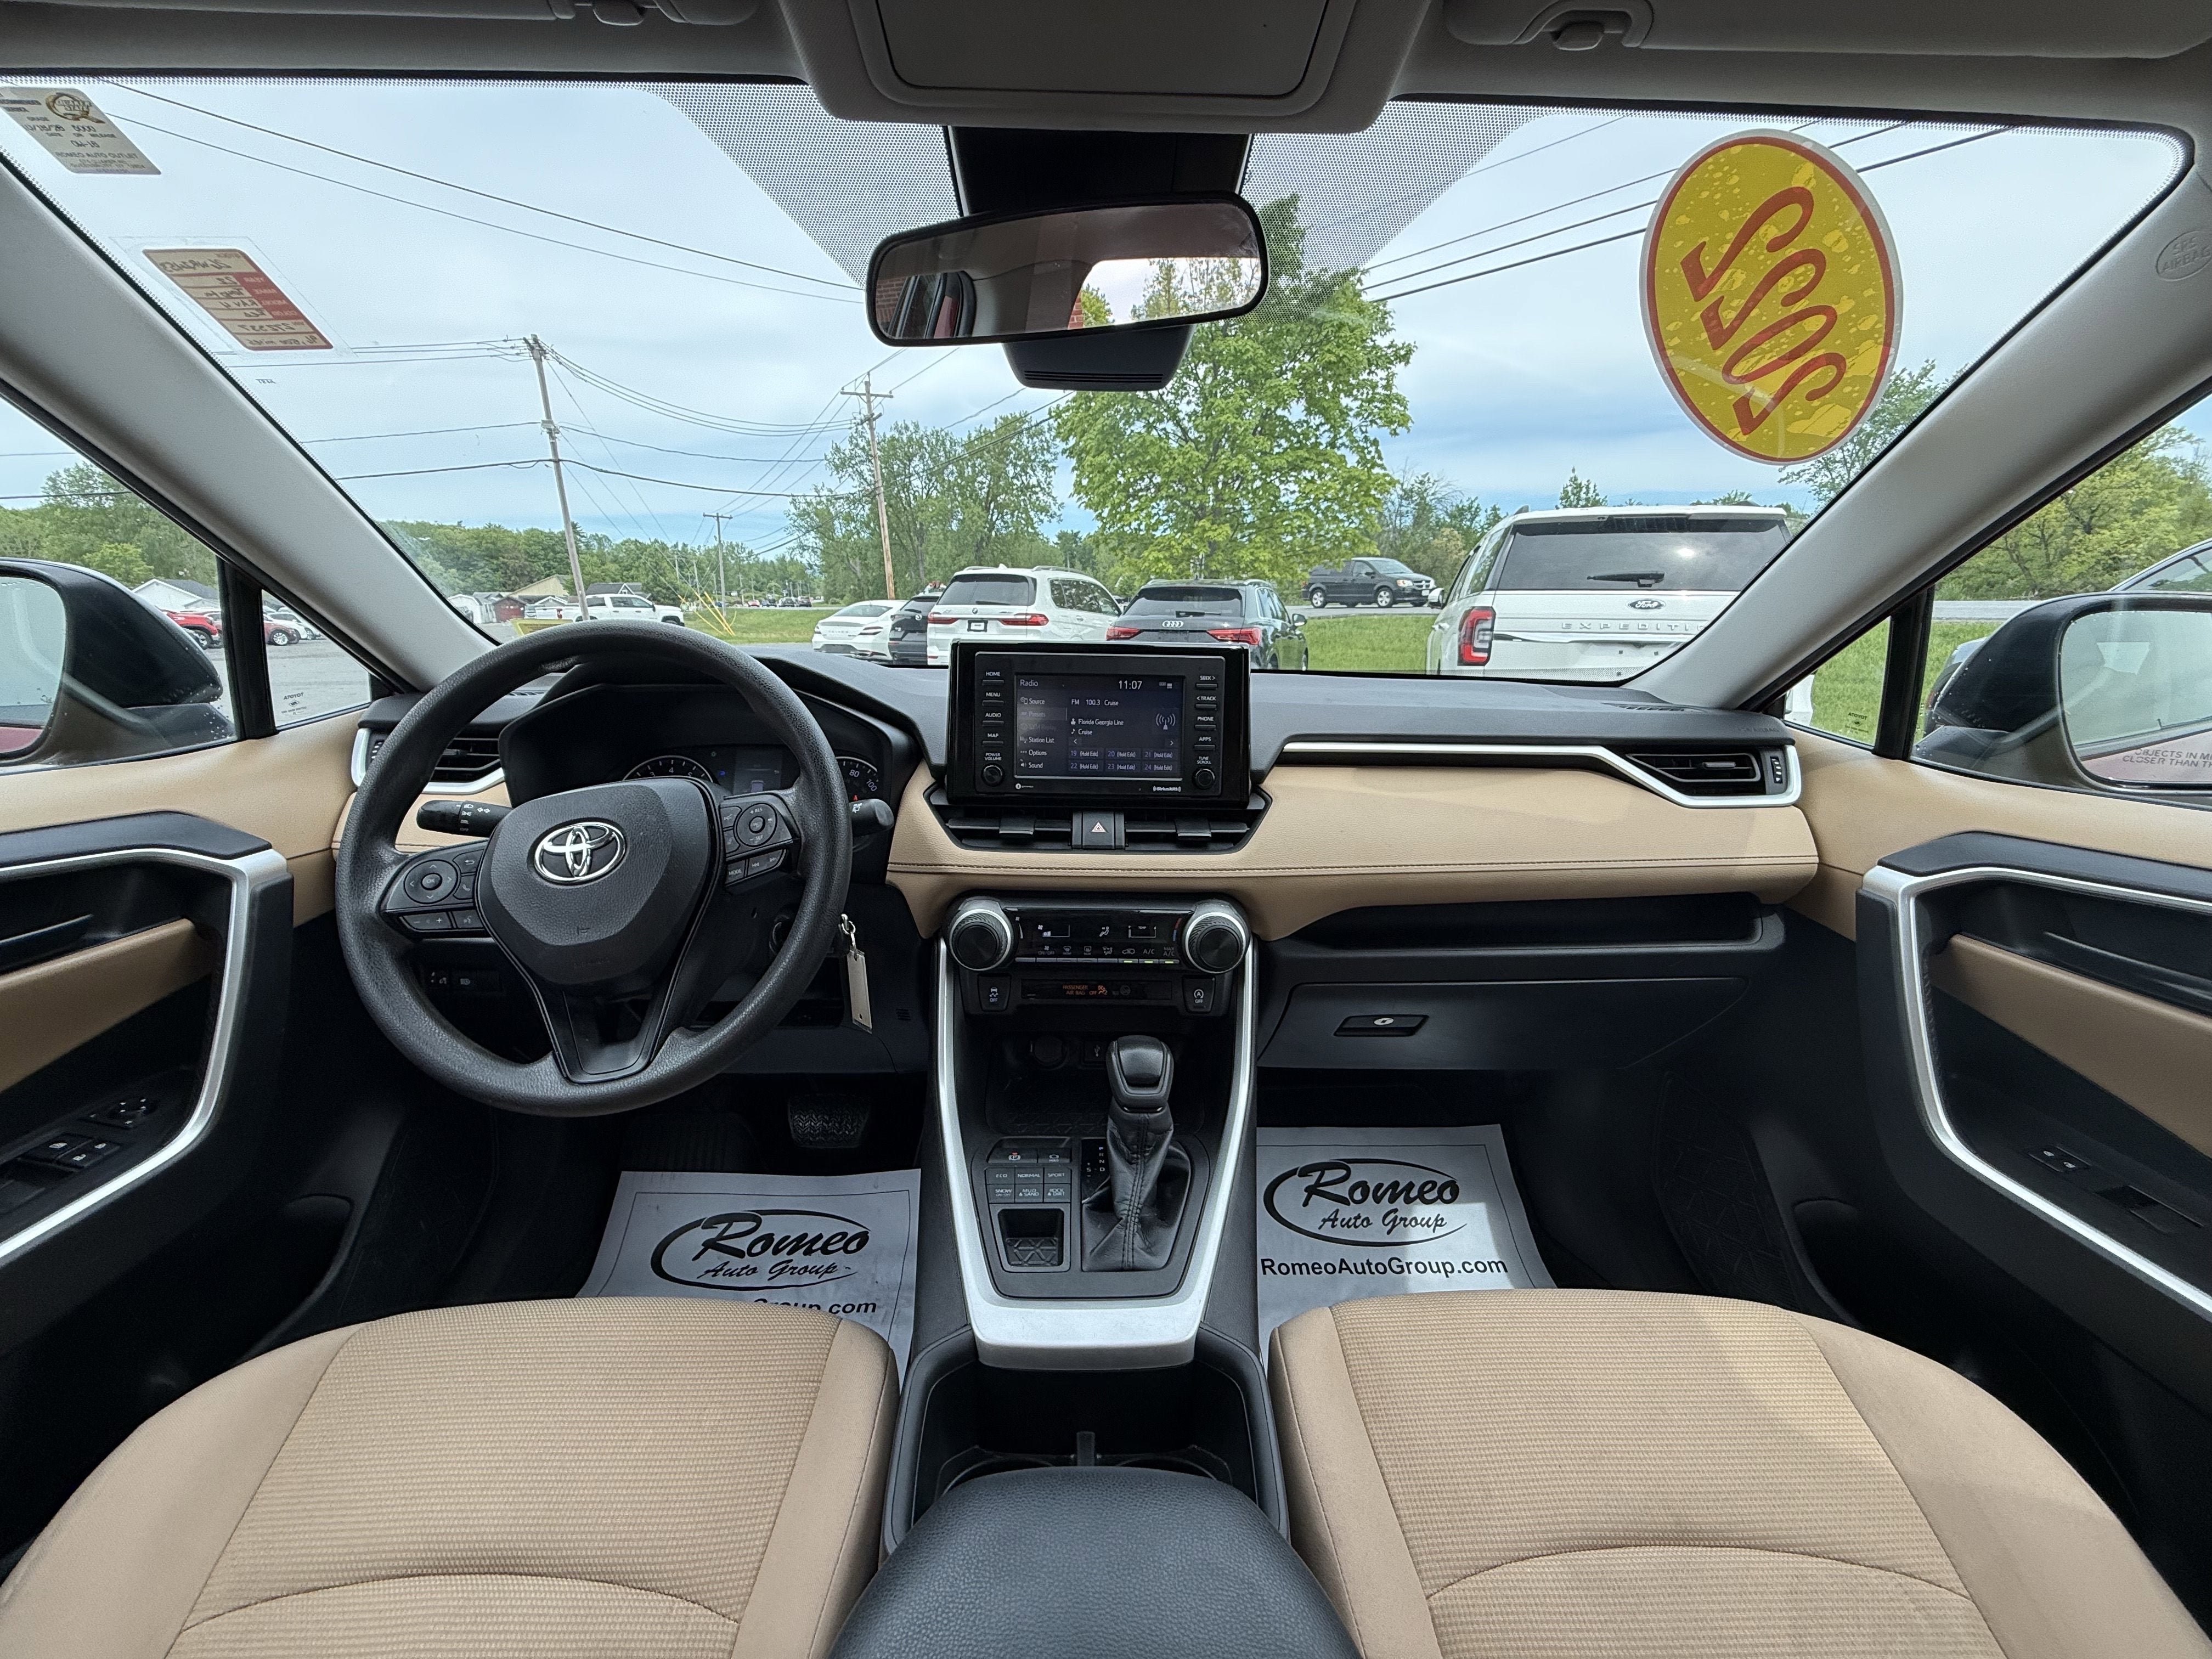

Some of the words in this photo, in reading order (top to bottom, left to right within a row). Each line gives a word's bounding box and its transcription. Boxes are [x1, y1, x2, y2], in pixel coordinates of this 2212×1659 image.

[1020, 679, 1039, 687] Radio
[1118, 680, 1143, 690] 11:07
[2122, 755, 2166, 765] CLOSER
[2169, 758, 2199, 768] THAN
[2135, 748, 2183, 758] OBJECTS
[849, 769, 860, 777] 80
[866, 778, 878, 792] 100
[1297, 1160, 1460, 1208] Romeo
[1318, 1207, 1373, 1230] Auto
[1381, 1207, 1447, 1235] Group
[692, 1212, 870, 1262] Romeo
[697, 1261, 758, 1279] Auto
[768, 1259, 838, 1281] Group
[1261, 1257, 1508, 1278] RomeoAutoGroup.com
